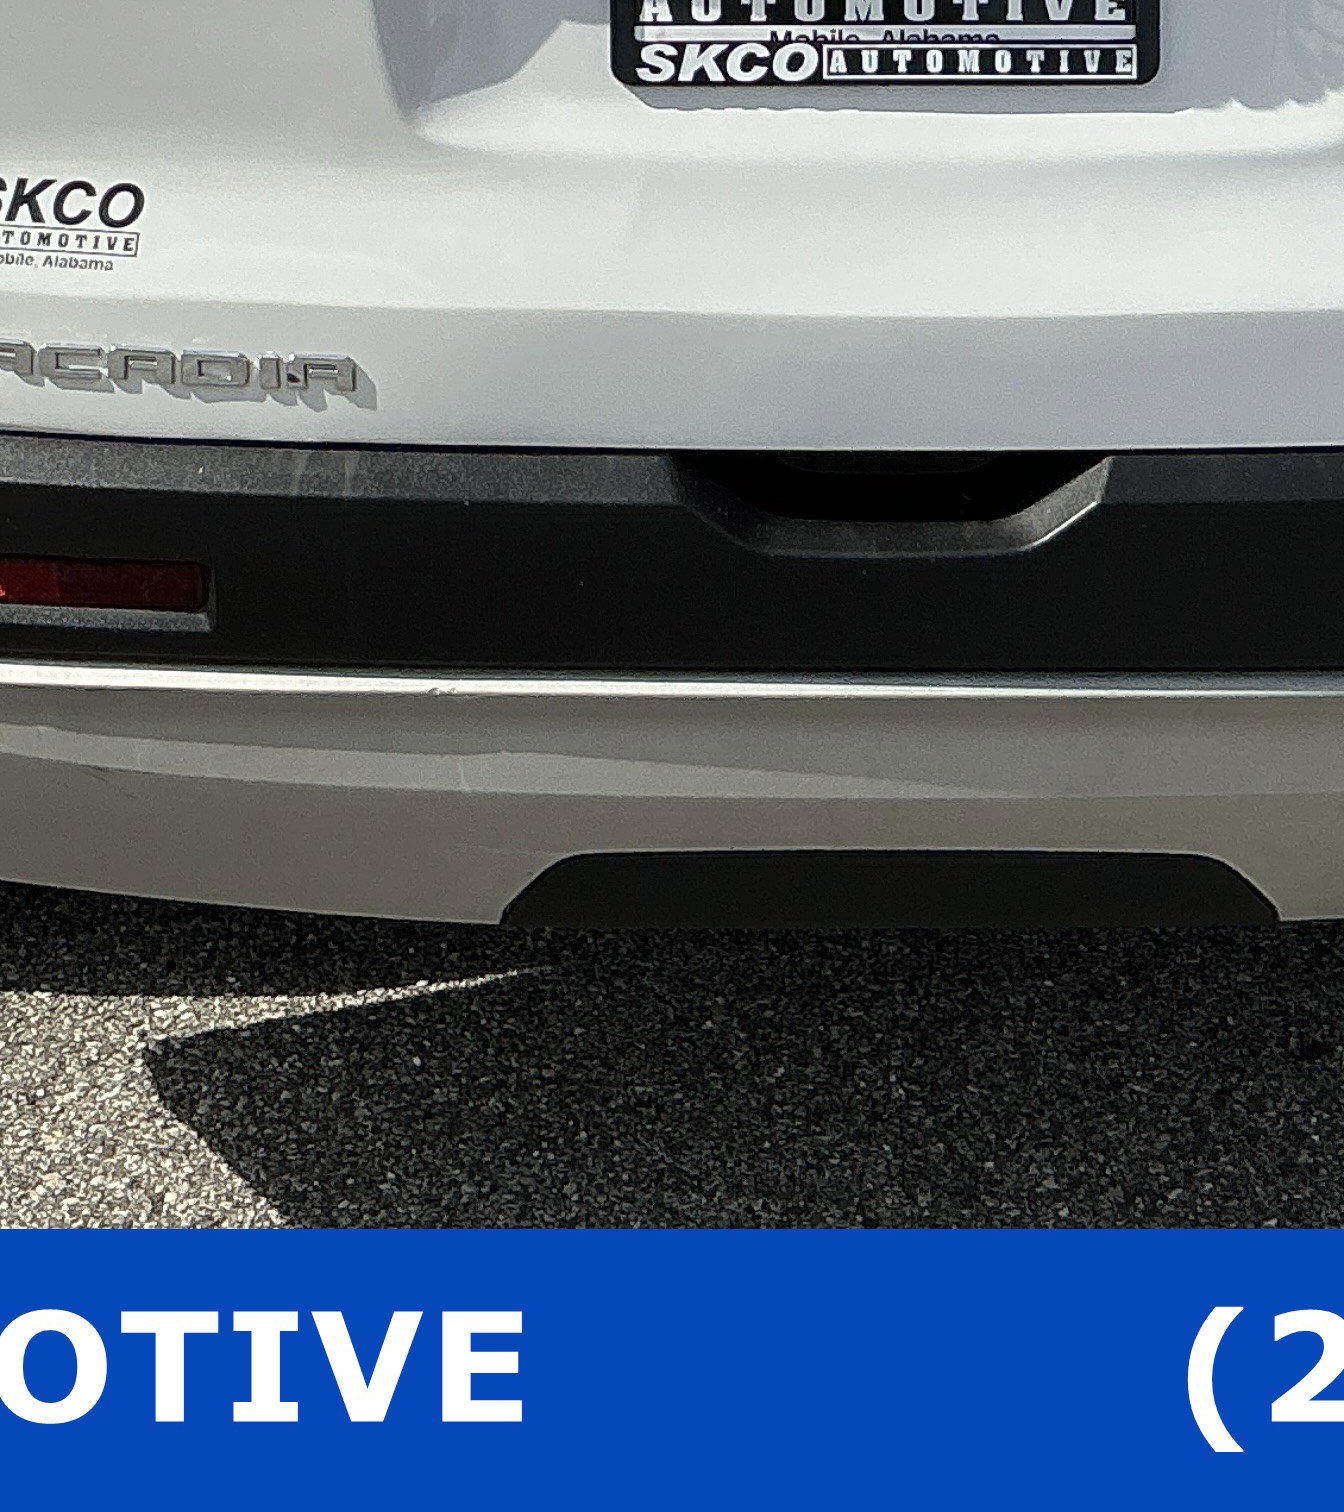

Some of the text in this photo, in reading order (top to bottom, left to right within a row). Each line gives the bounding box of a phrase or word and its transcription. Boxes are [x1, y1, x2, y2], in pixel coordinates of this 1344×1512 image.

[635, 42, 820, 83] SKCO
[829, 48, 1134, 75] AUTOMOTIVE
[42, 255, 114, 272] Alabama
